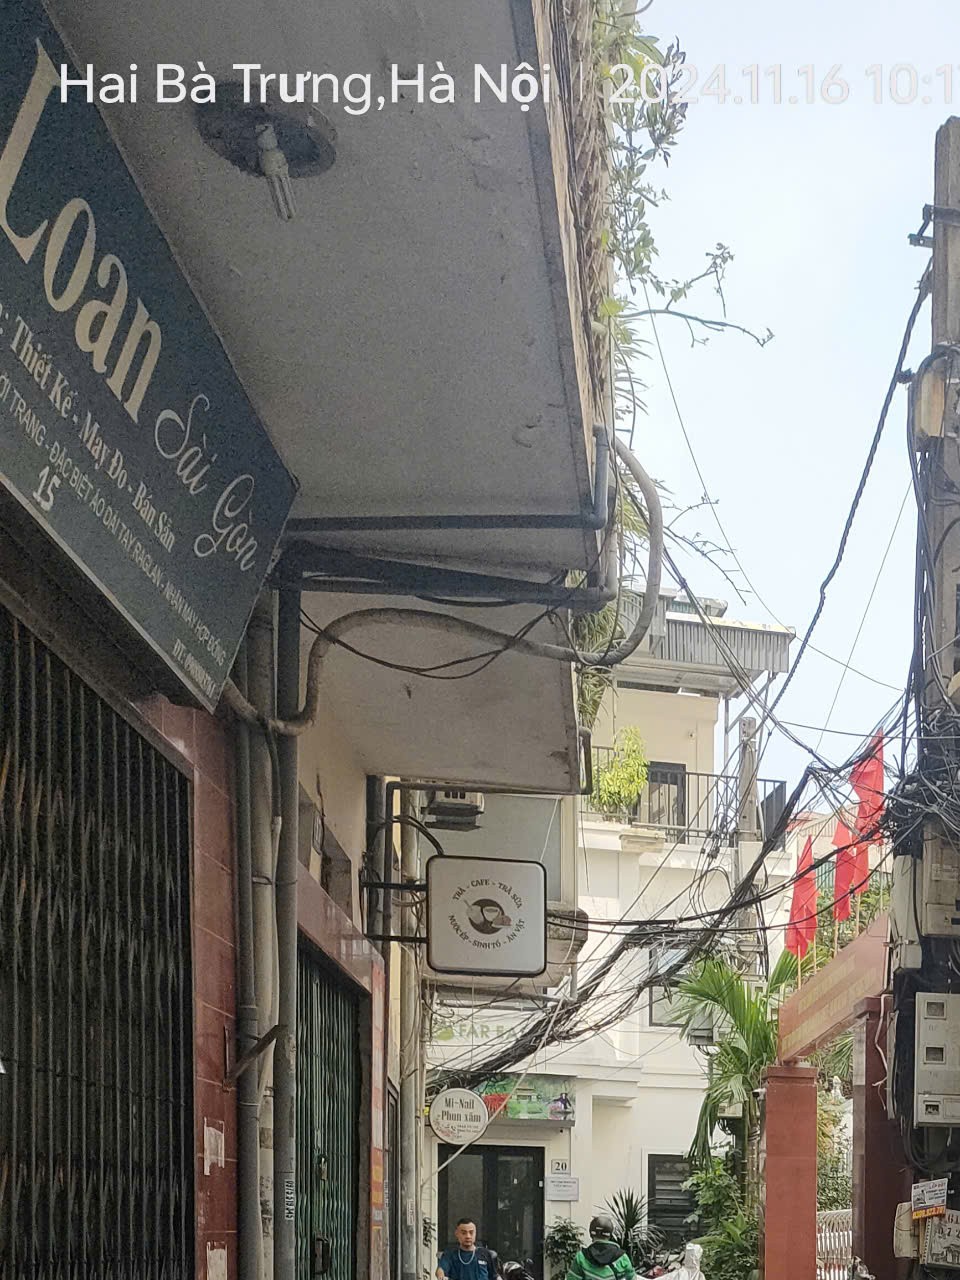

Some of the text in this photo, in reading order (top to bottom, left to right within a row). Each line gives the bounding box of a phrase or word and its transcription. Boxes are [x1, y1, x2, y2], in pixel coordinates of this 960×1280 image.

[0, 37, 162, 424] Loan
[10, 315, 52, 390] Thiết
[48, 371, 78, 418] Kế
[78, 409, 111, 470] May
[105, 448, 128, 489] Đo
[132, 481, 153, 527] Bán
[9, 388, 46, 447] TRANG
[89, 488, 106, 517] ÁO
[102, 505, 121, 536] DÀI
[118, 522, 137, 553] TAY
[155, 394, 257, 571] Sài Gòn
[33, 466, 61, 511] 15
[471, 879, 490, 887] CAFE
[459, 1023, 490, 1039] FAR
[441, 1110, 481, 1123] Phun xăm
[444, 1097, 475, 1110] Mi-Nail
[555, 1161, 567, 1171] 20
